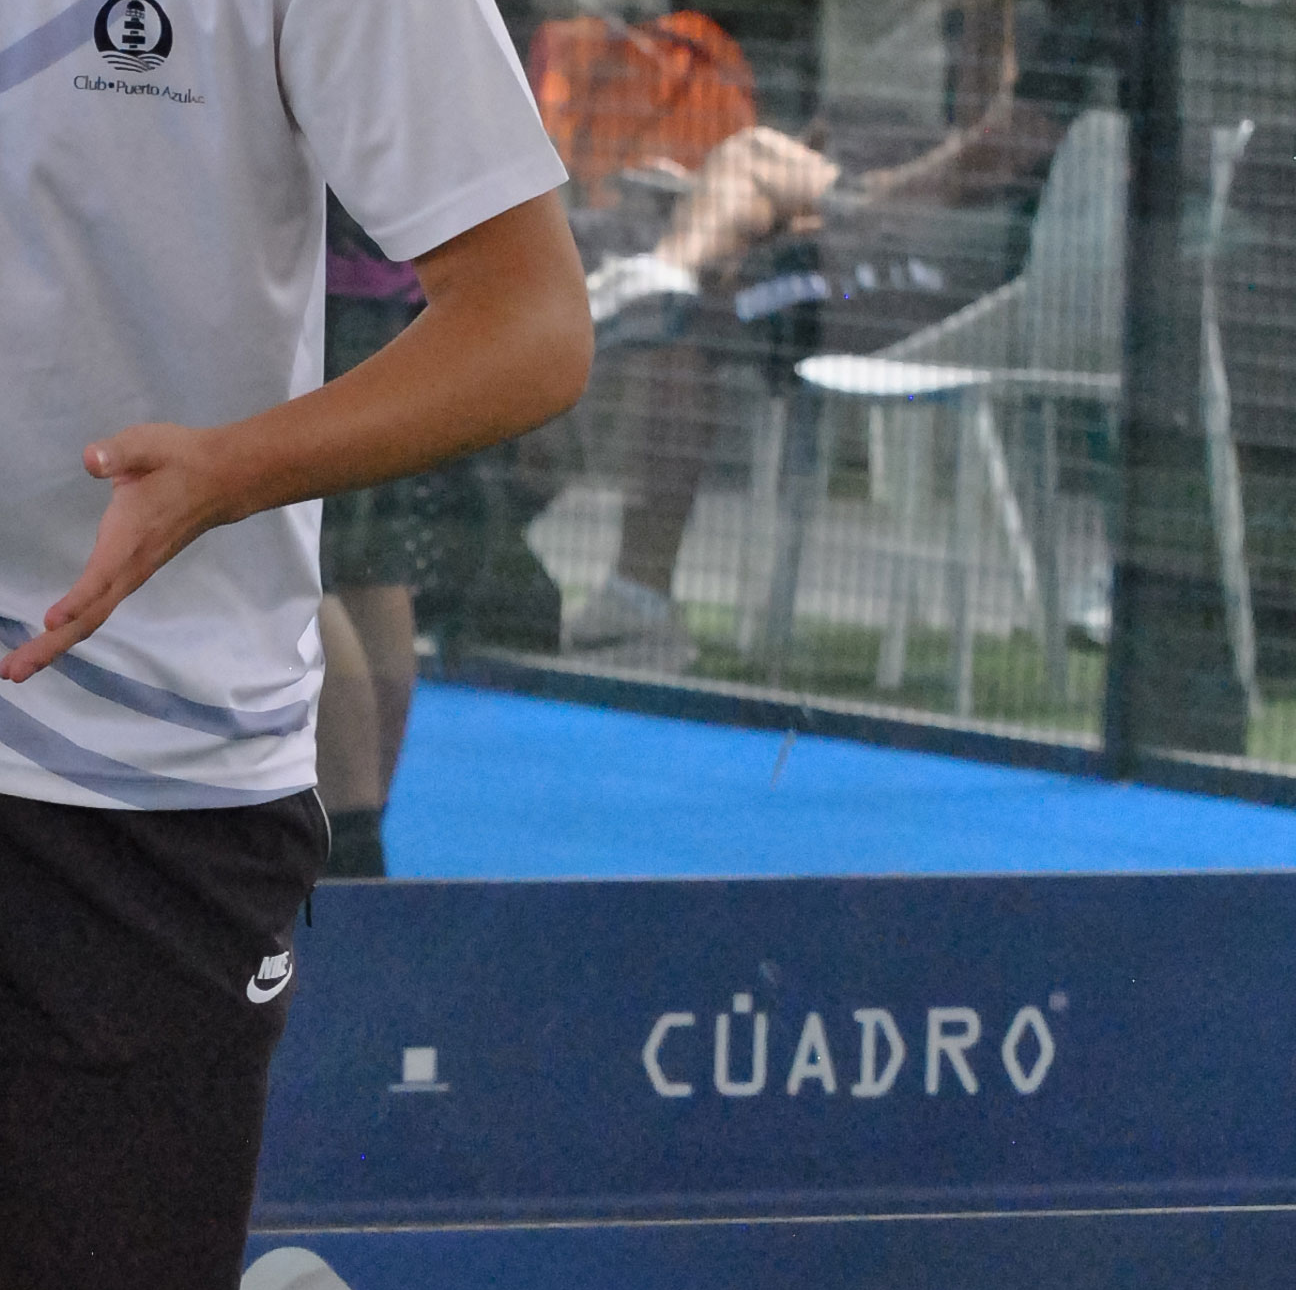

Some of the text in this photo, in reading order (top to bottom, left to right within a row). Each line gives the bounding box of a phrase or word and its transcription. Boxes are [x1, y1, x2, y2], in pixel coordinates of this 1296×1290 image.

[73, 75, 106, 91] Club
[116, 80, 160, 96] Puerto
[162, 86, 191, 104] Azul
